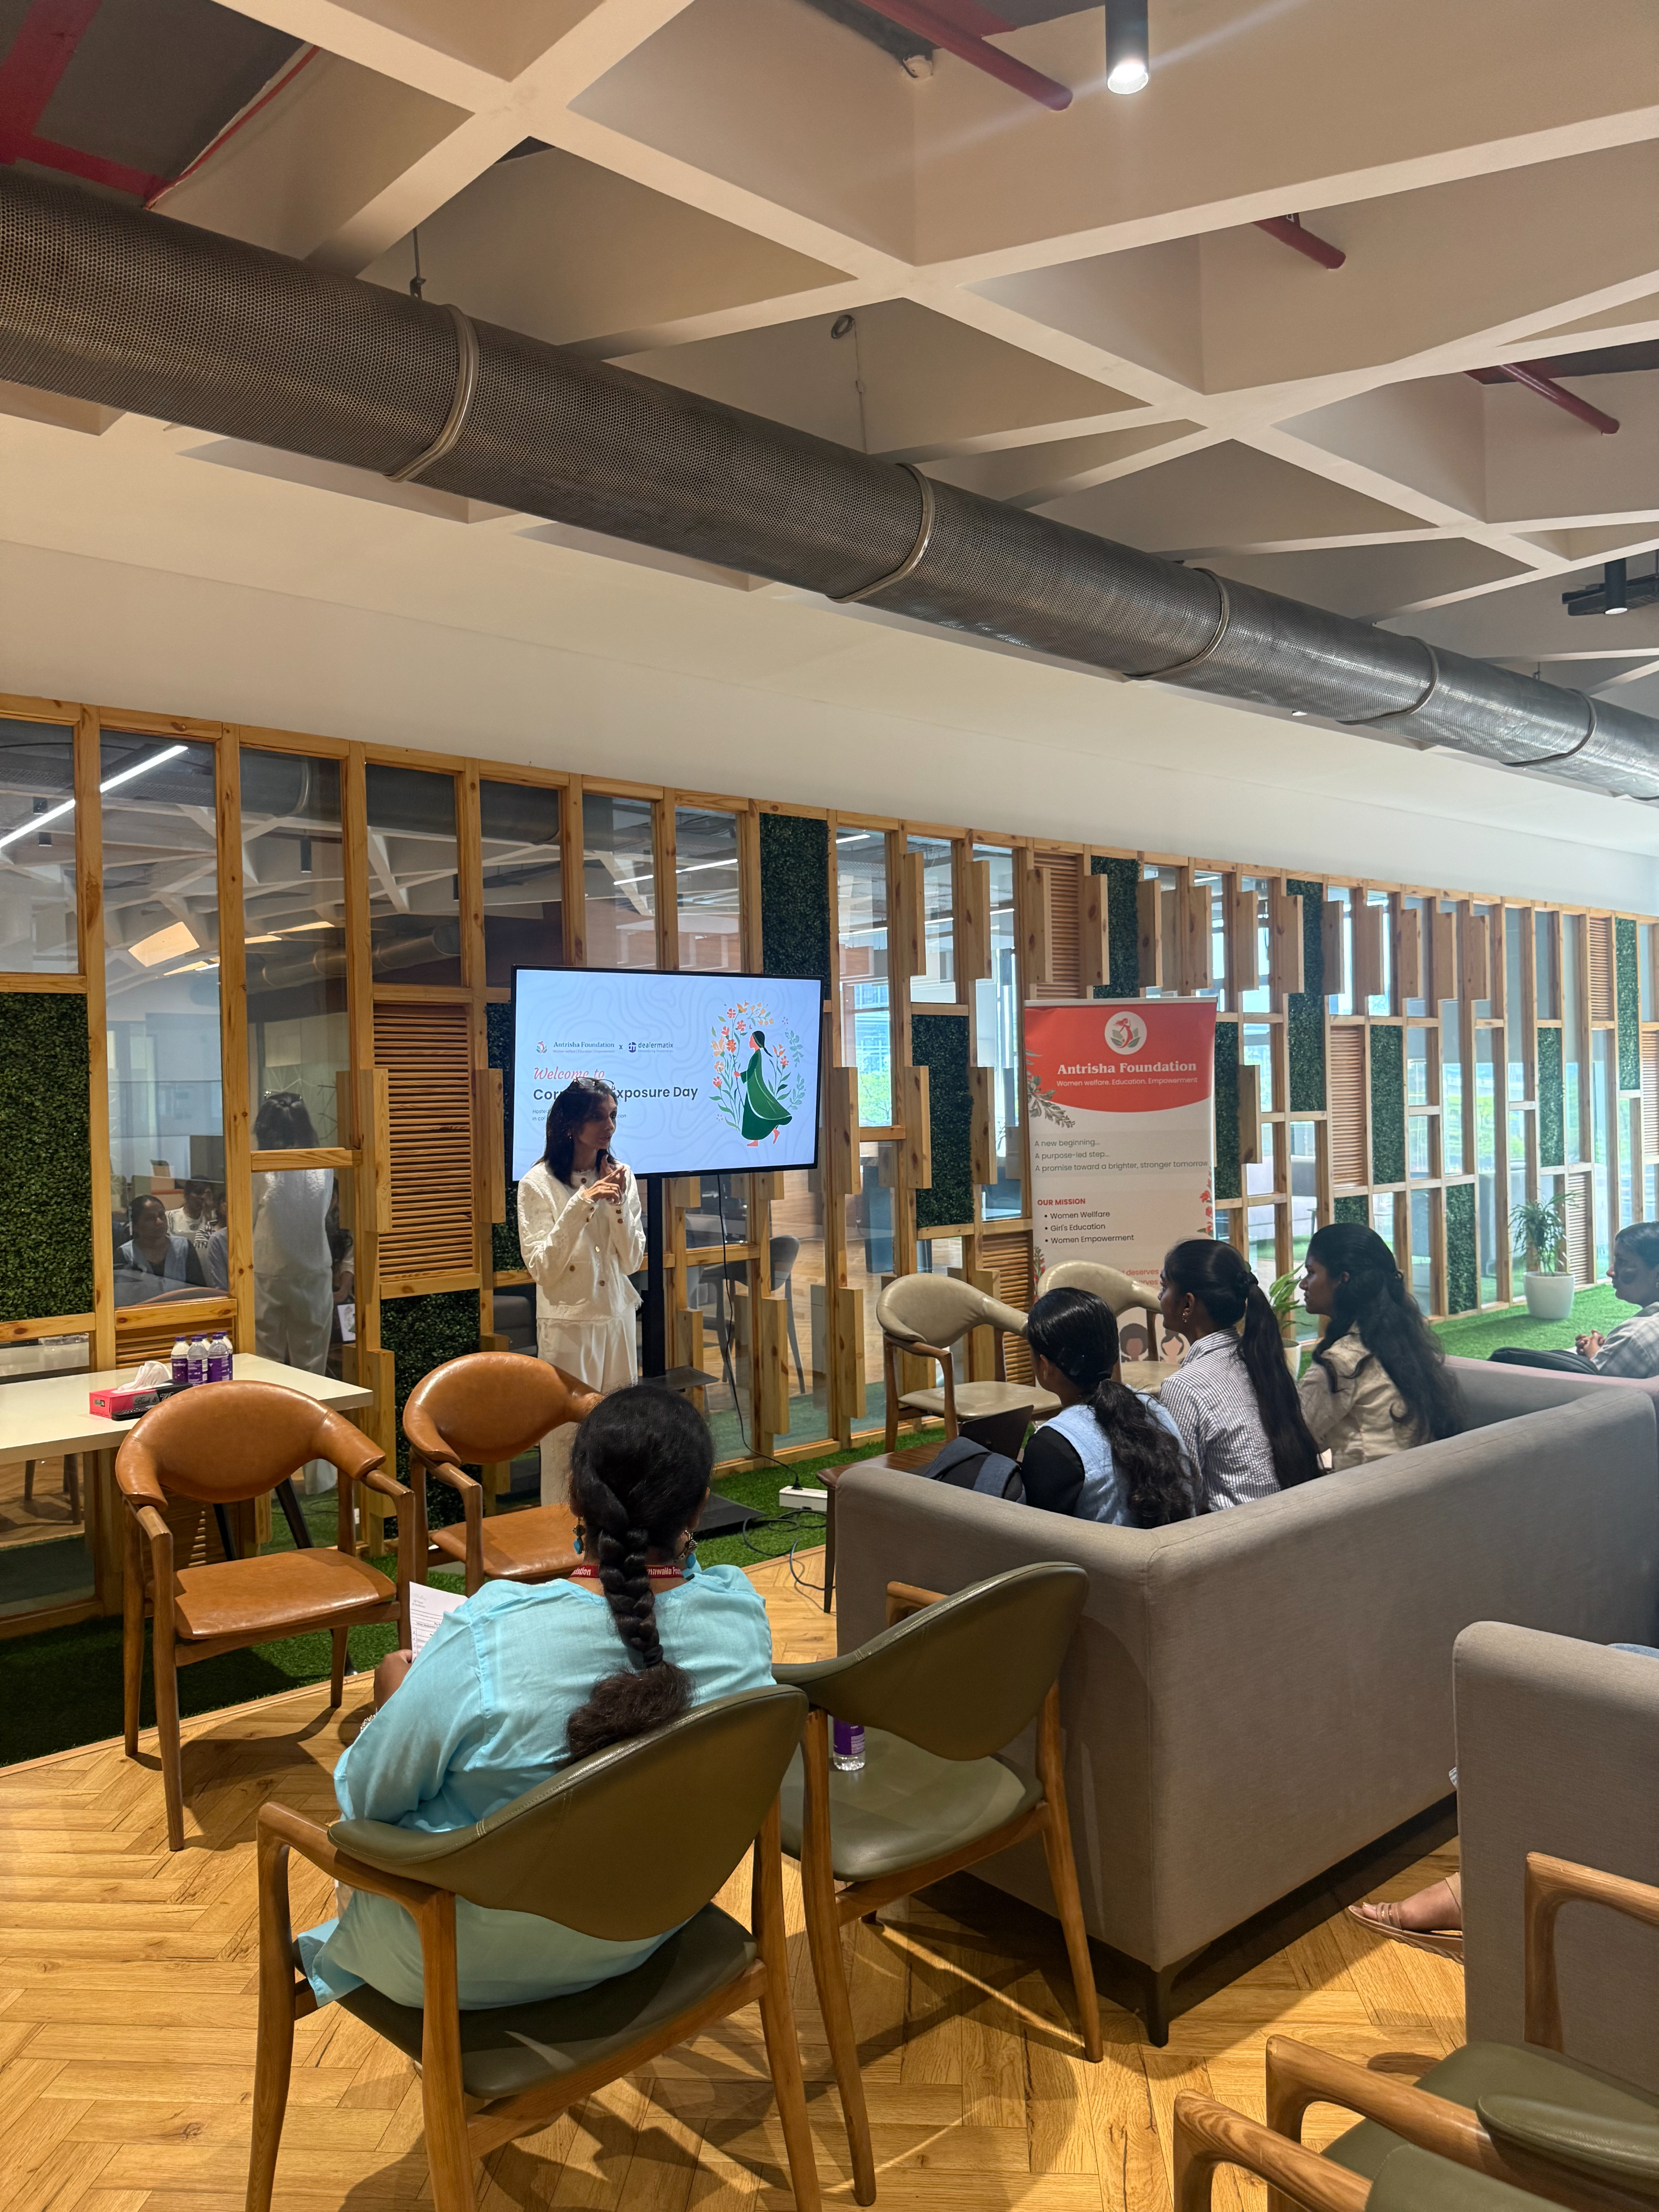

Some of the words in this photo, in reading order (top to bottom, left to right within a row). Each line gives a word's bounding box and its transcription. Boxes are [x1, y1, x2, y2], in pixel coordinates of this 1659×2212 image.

[534, 1066, 589, 1080] Welcome
[593, 1068, 605, 1079] to
[1057, 1063, 1115, 1075] Antrisha
[1120, 1061, 1197, 1073] Foundation
[1148, 1077, 1198, 1085] Empowerment
[533, 1089, 562, 1100] Cor
[613, 1087, 670, 1102] xposure
[673, 1087, 698, 1101] Day
[1041, 1151, 1087, 1161] purpose-led
[1042, 1163, 1073, 1173] promise
[1108, 1162, 1139, 1171] brighter,
[1140, 1162, 1171, 1170] stronger
[1069, 1223, 1105, 1231] Education
[1081, 1235, 1134, 1244] Empowerment
